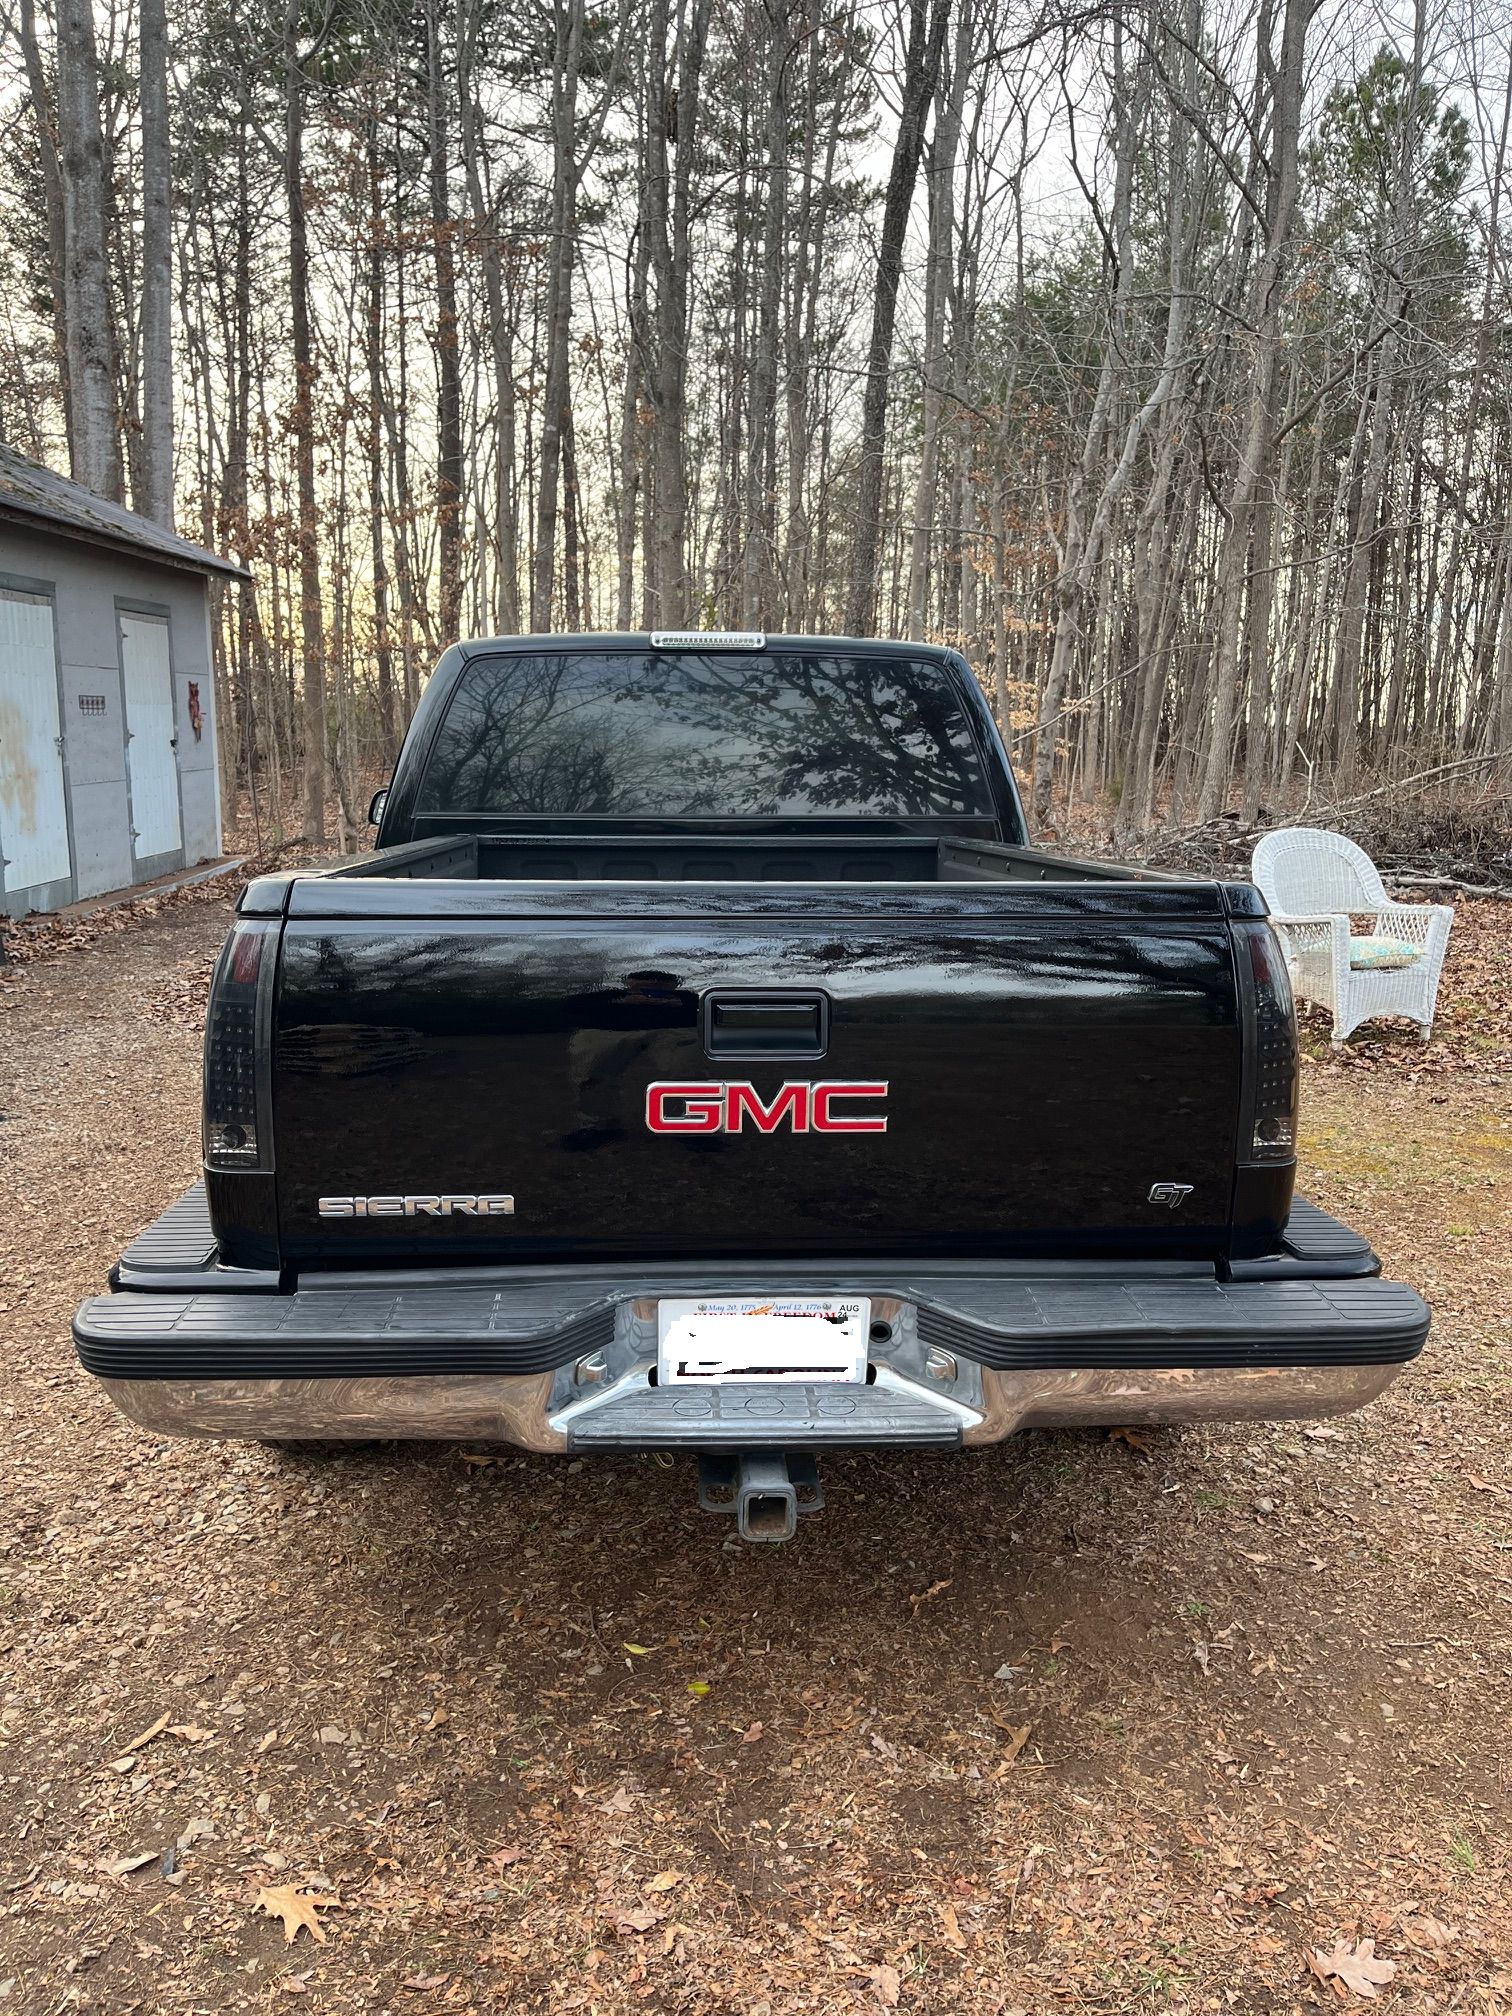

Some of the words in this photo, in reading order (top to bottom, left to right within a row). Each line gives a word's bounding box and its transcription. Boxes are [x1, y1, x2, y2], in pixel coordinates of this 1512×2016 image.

[645, 1080, 889, 1134] GMC
[1147, 1182, 1194, 1209] GT
[318, 1194, 515, 1218] SIERRA
[708, 1303, 725, 1312] May
[740, 1303, 757, 1311] 1775
[774, 1302, 792, 1312] April
[806, 1303, 822, 1311] 1776
[839, 1304, 860, 1312] AUG
